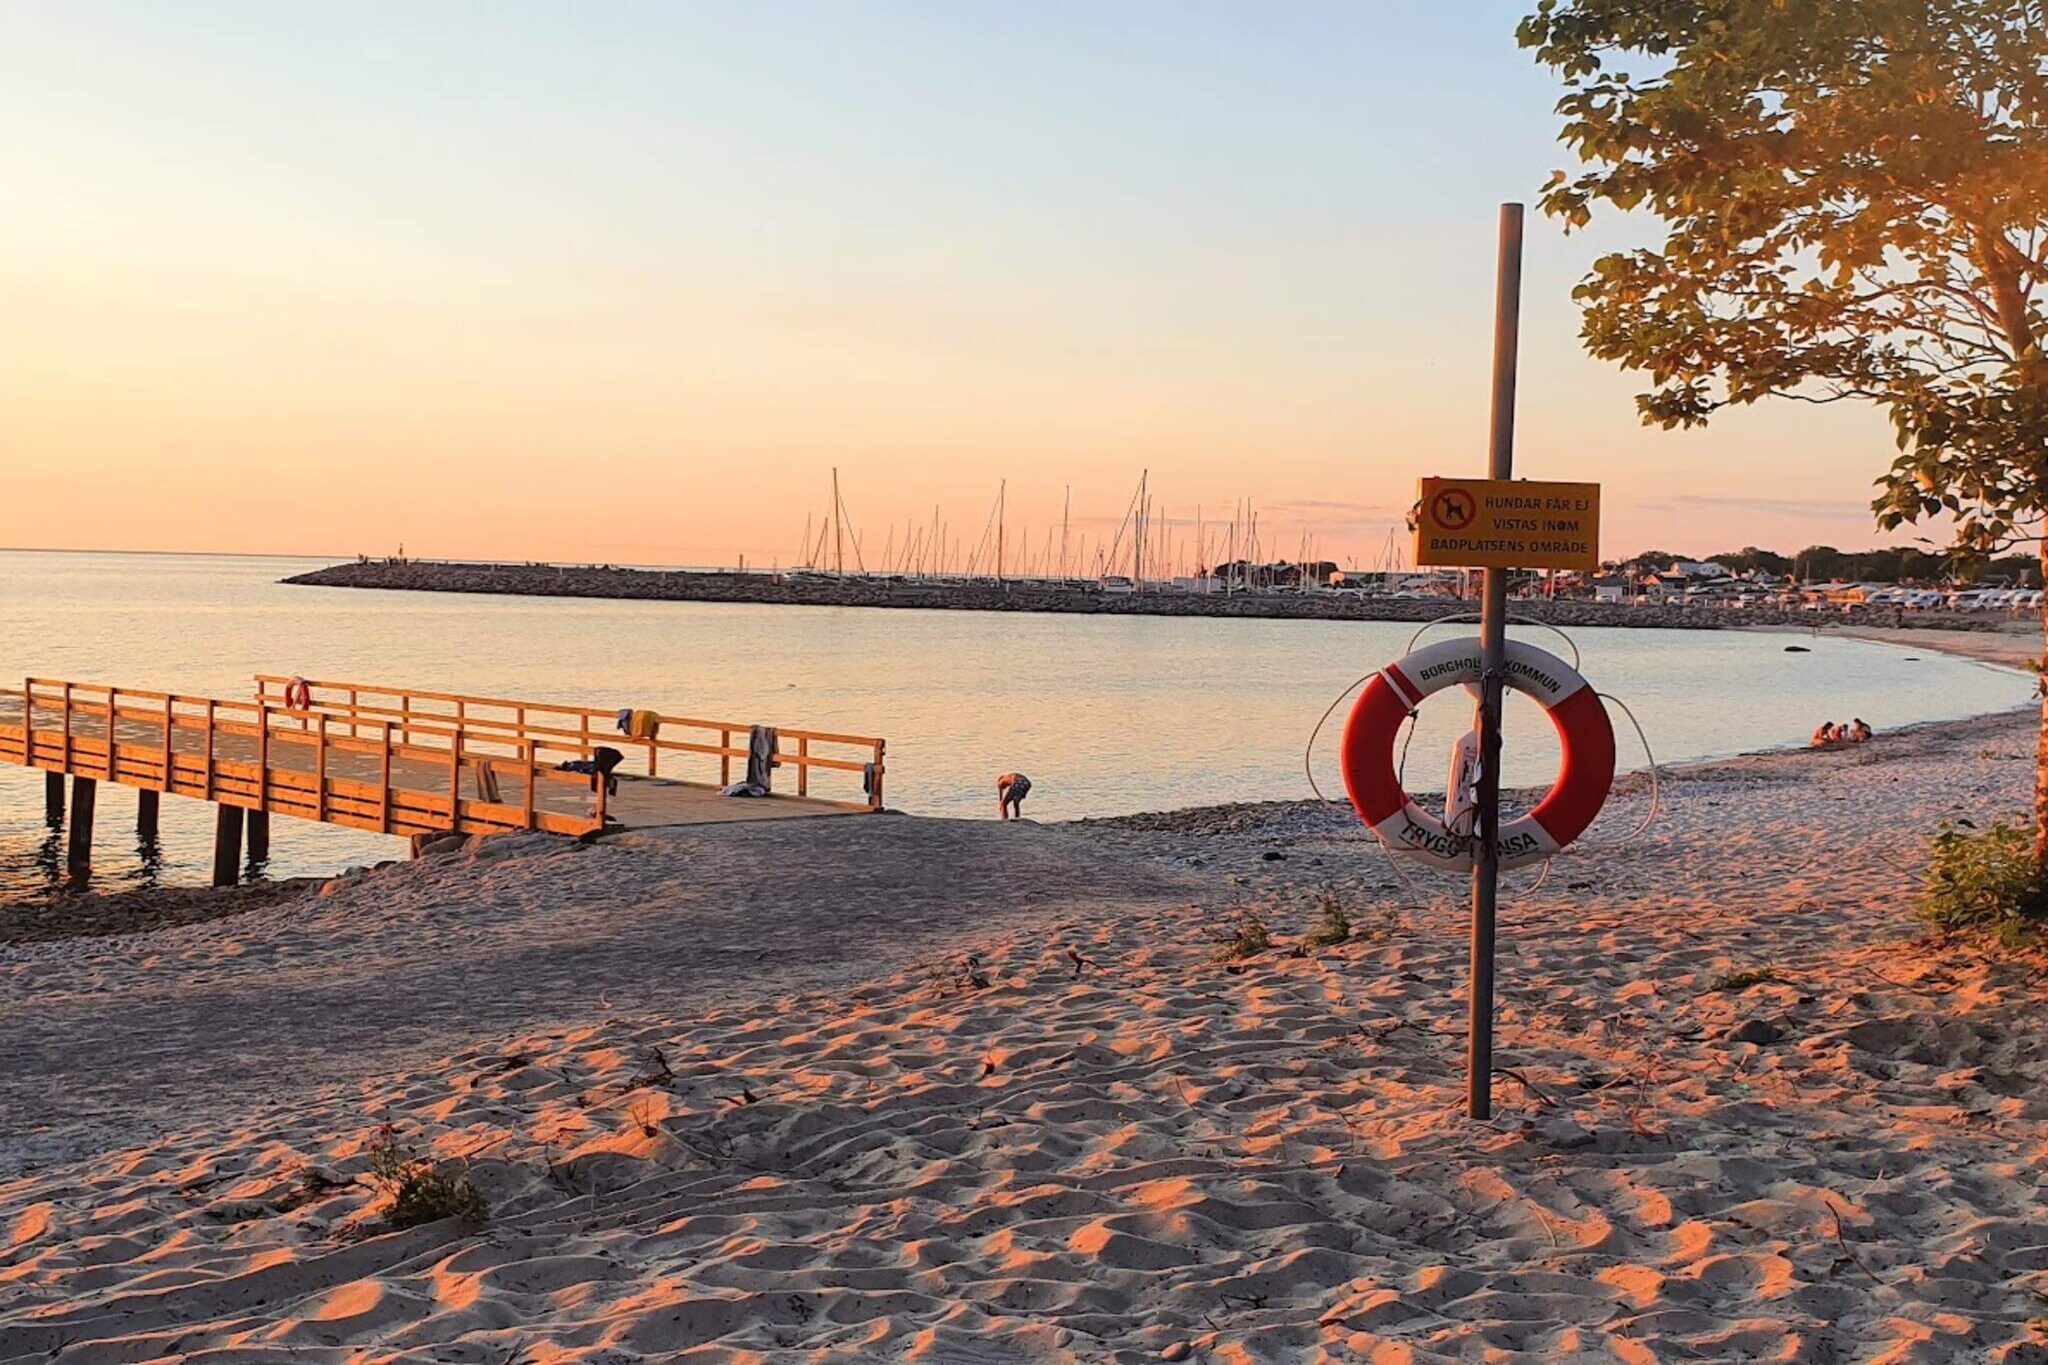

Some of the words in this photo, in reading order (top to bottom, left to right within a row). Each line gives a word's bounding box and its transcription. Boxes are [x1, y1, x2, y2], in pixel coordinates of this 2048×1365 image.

[1485, 496, 1541, 510] HUNDAR
[1546, 496, 1570, 511] FÅR
[1575, 499, 1589, 511] EJ
[1492, 518, 1537, 531] VISTAS
[1543, 519, 1579, 532] INOM
[1430, 538, 1524, 552] BADPLATSENS
[1502, 658, 1562, 693] KOMMUN
